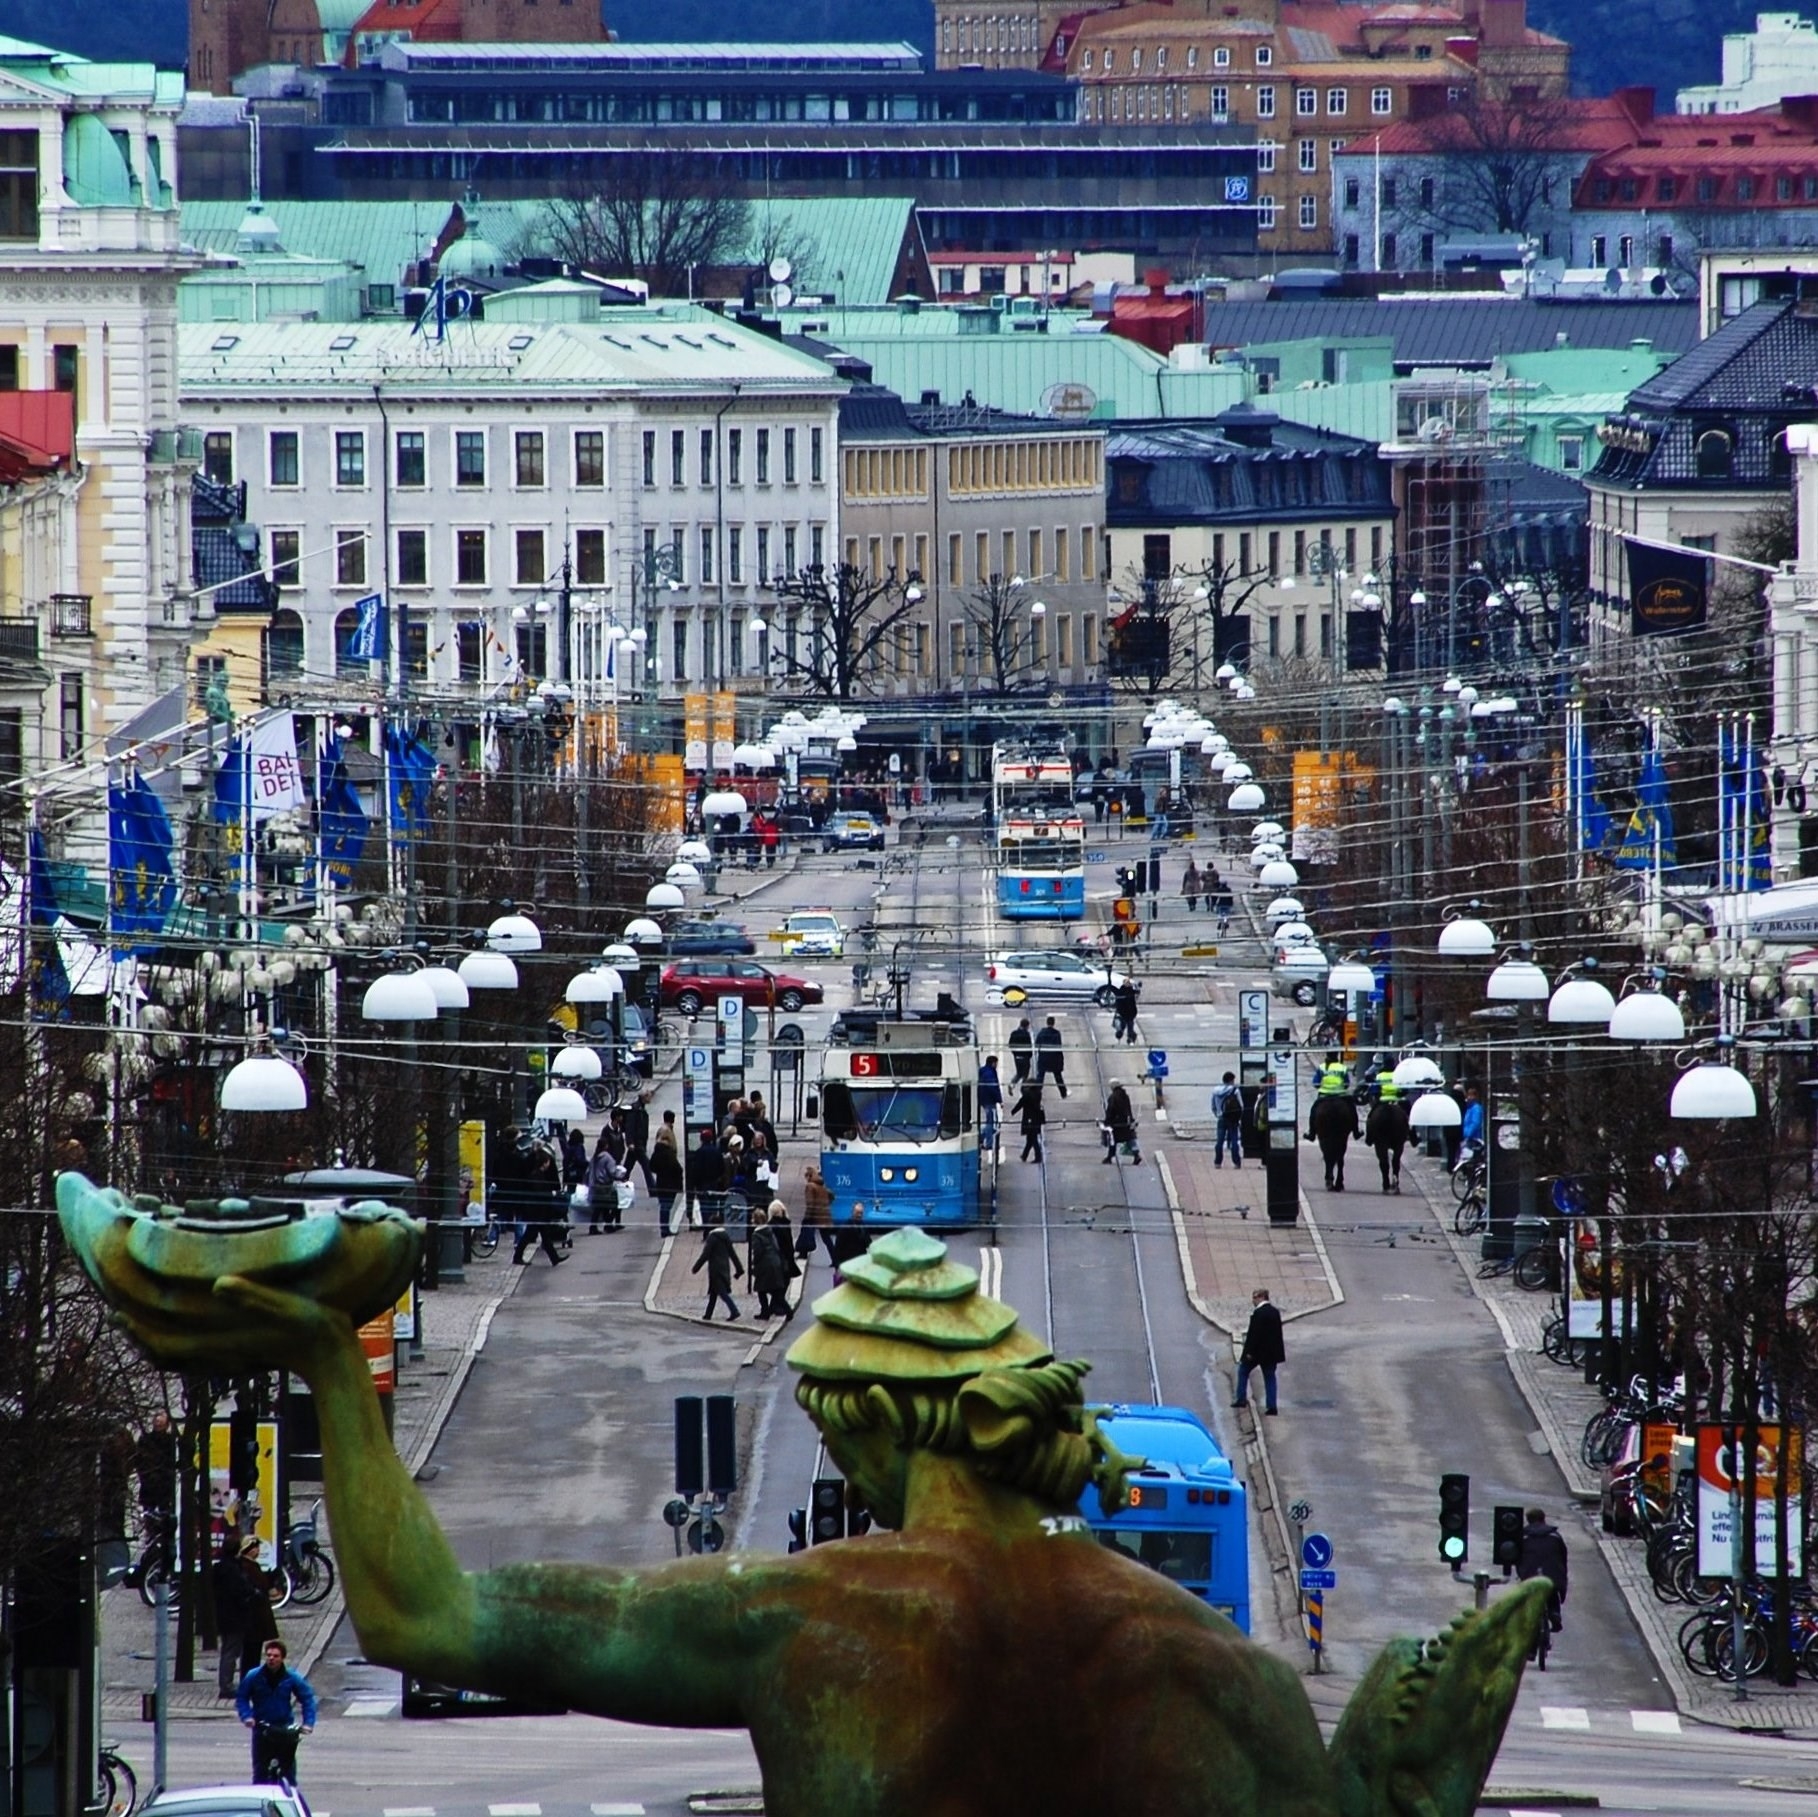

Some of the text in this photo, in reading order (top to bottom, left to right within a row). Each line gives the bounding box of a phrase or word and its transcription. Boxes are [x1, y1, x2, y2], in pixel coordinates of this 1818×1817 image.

[725, 1001, 737, 1015] D
[1248, 994, 1260, 1010] C
[692, 1050, 705, 1067] D
[858, 1055, 871, 1075] 5
[1712, 1534, 1728, 1544] Nu
